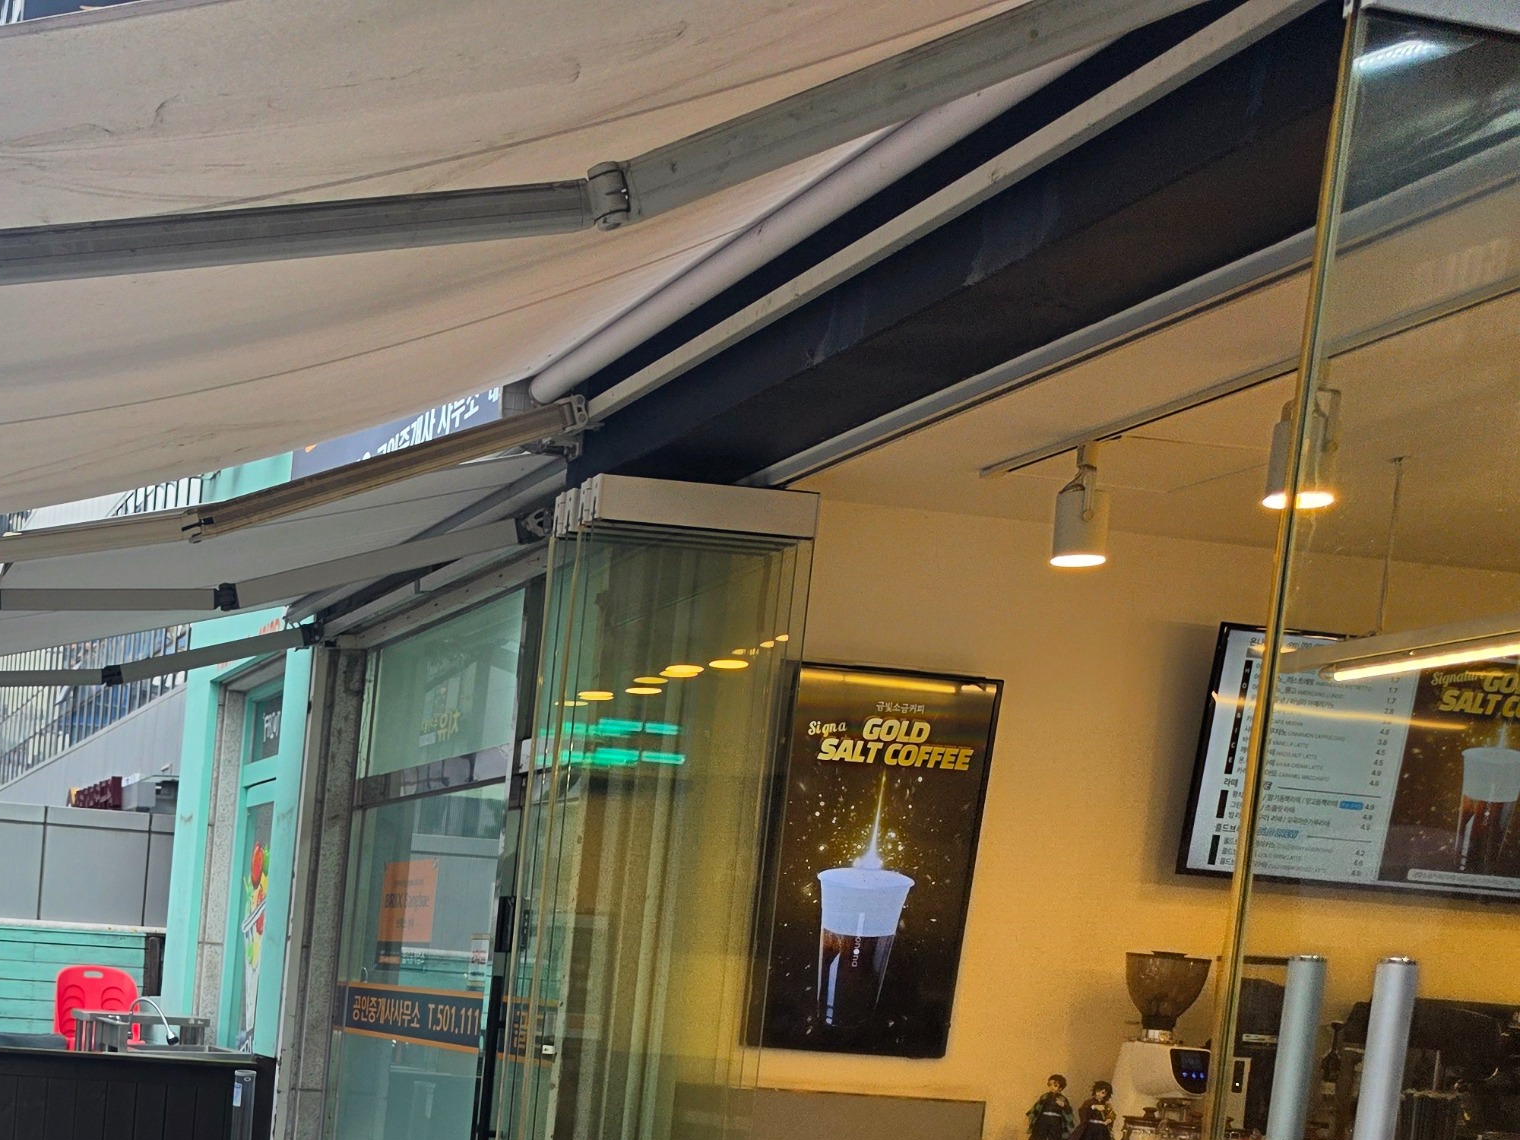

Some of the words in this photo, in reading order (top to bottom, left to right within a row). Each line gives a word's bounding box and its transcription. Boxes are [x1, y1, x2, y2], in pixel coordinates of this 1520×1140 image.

[876, 701, 926, 714] 금빛소금커피
[1439, 688, 1503, 715] SALT
[862, 717, 931, 744] GOLD
[817, 738, 884, 764] SALT
[884, 743, 975, 771] COFFEE
[352, 994, 421, 1030] 공인중개사사무소
